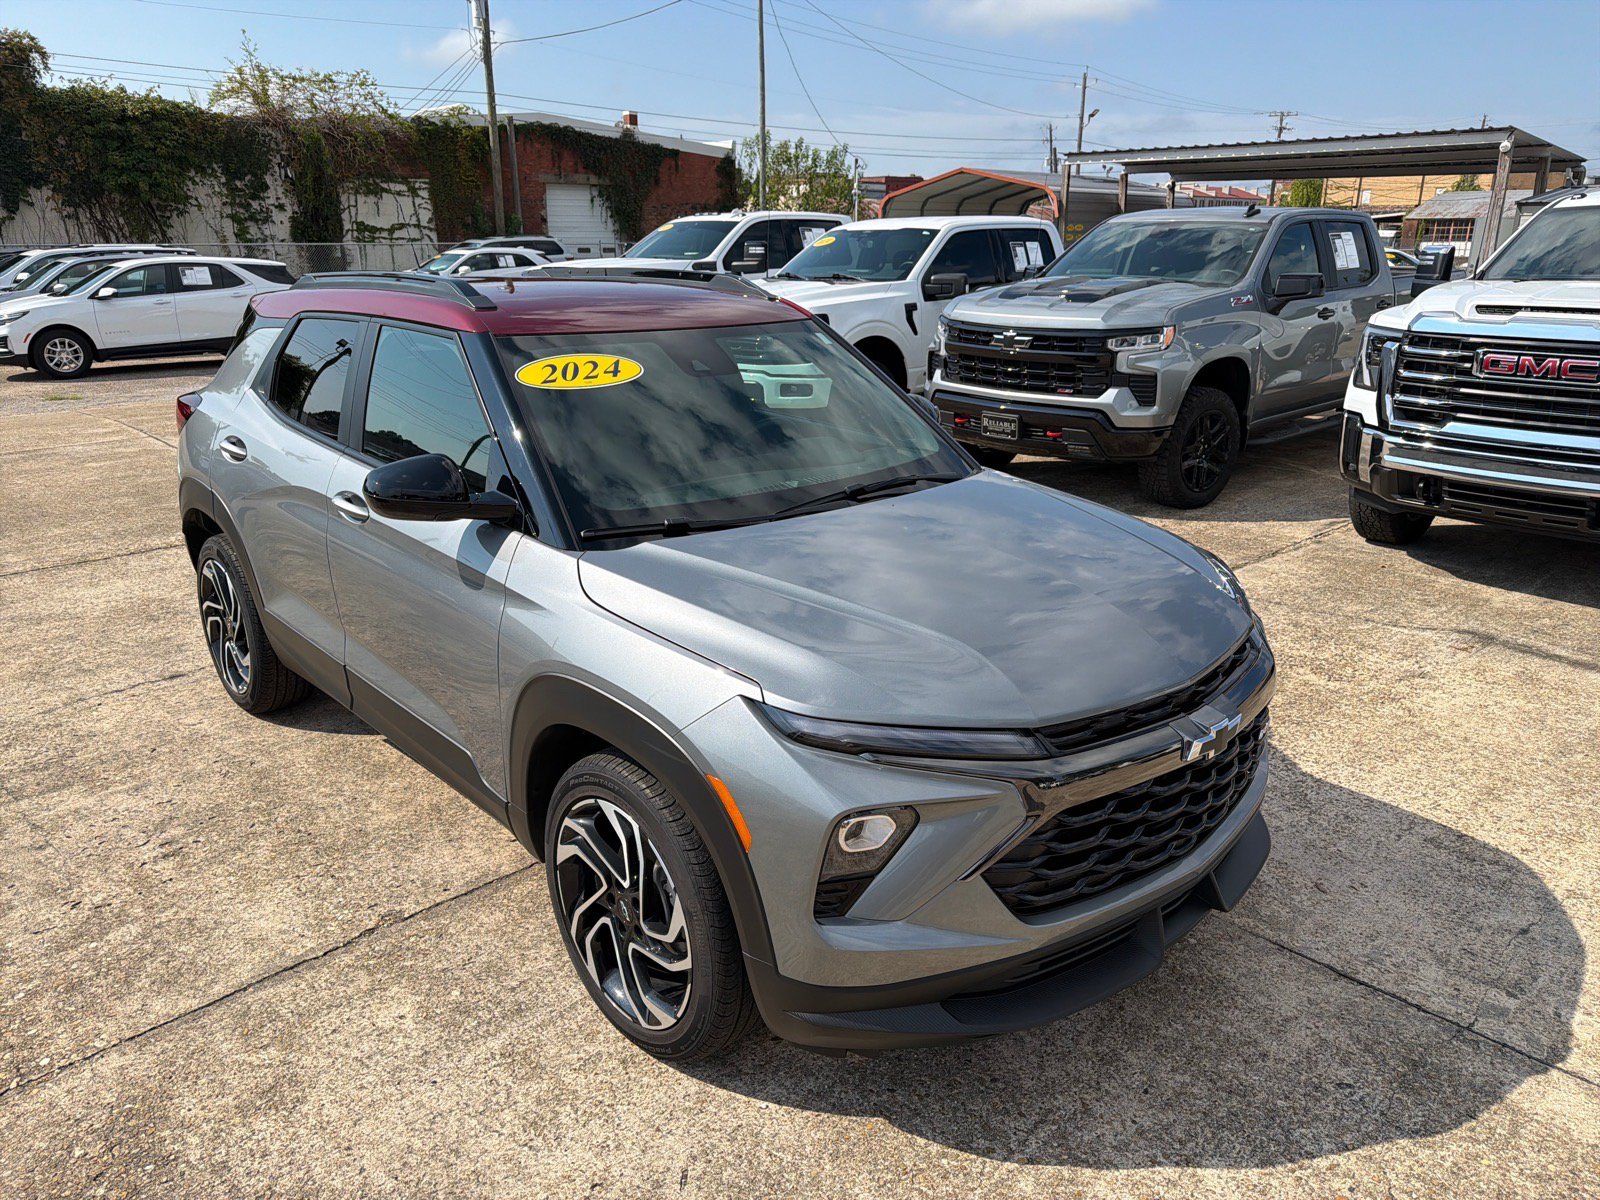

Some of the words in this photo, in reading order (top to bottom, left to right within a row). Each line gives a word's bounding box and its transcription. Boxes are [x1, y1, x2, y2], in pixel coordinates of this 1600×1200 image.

[541, 359, 621, 384] 2024
[1482, 353, 1599, 380] GMC
[983, 417, 1016, 430] RELIABLE
